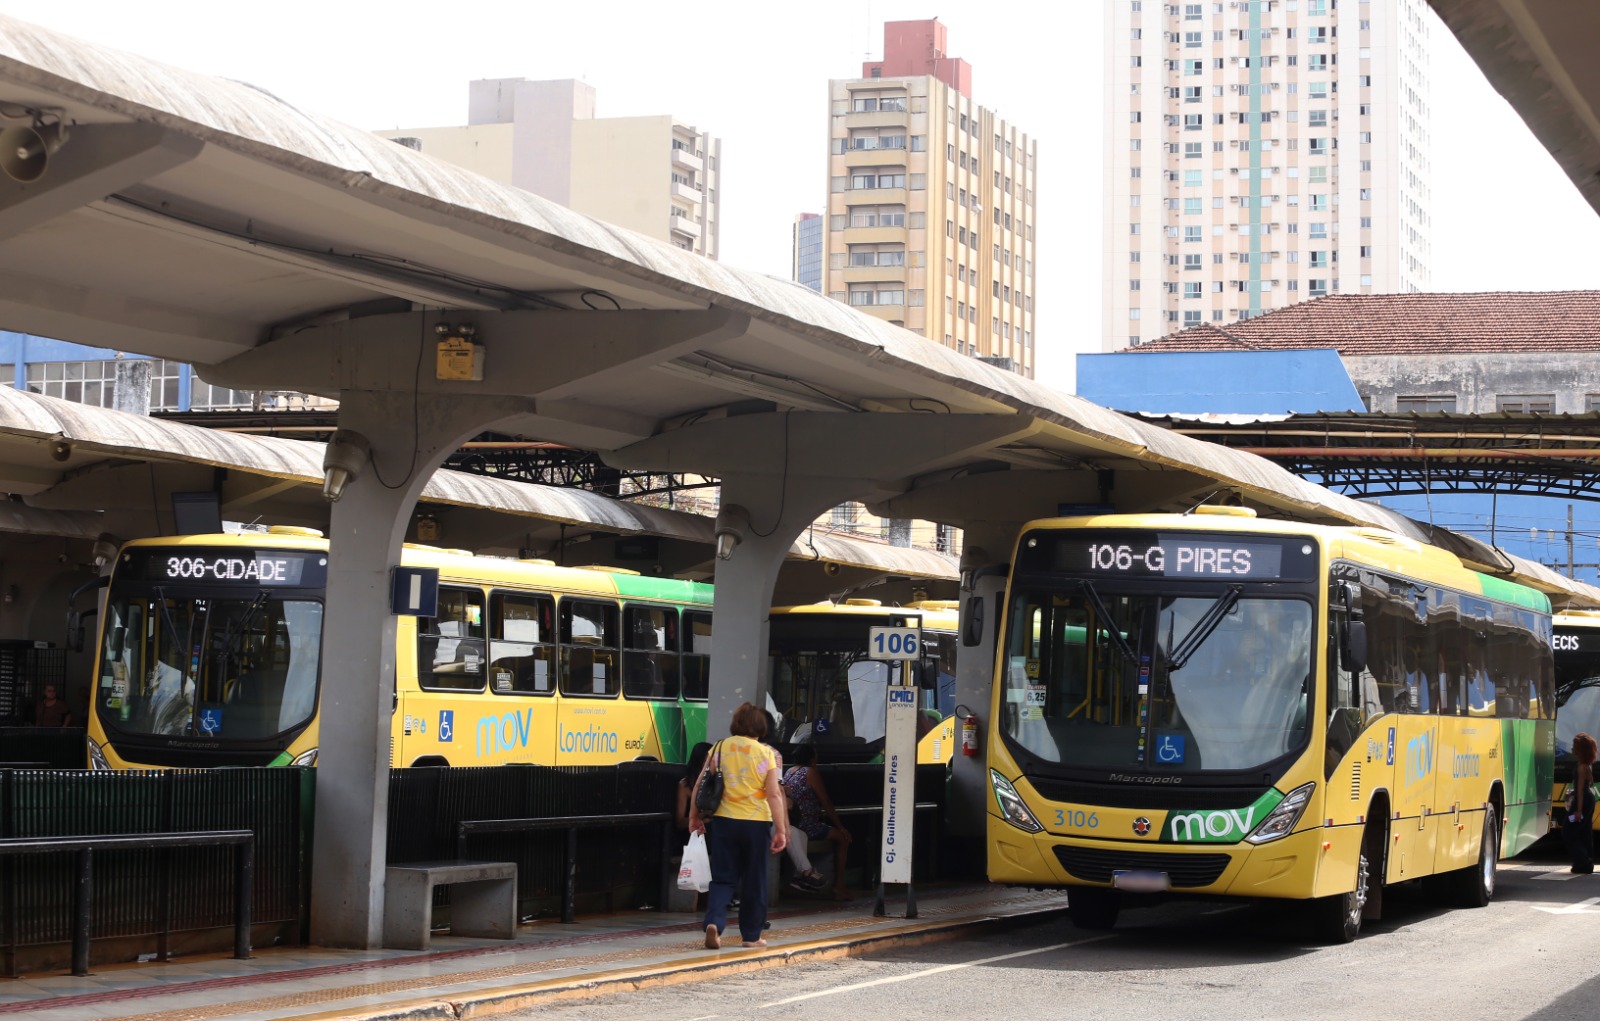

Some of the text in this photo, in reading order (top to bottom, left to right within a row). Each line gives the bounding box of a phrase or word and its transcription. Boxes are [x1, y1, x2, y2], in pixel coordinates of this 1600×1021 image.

[166, 557, 287, 581] 306-CIDADE
[1088, 544, 1252, 574] 106-G PIRES
[874, 632, 917, 654] 106
[559, 722, 618, 753] Londrina
[888, 755, 898, 783] Pires
[1108, 773, 1183, 785] Marcopolo
[886, 787, 897, 845] Guilherme
[1053, 809, 1099, 829] 3106
